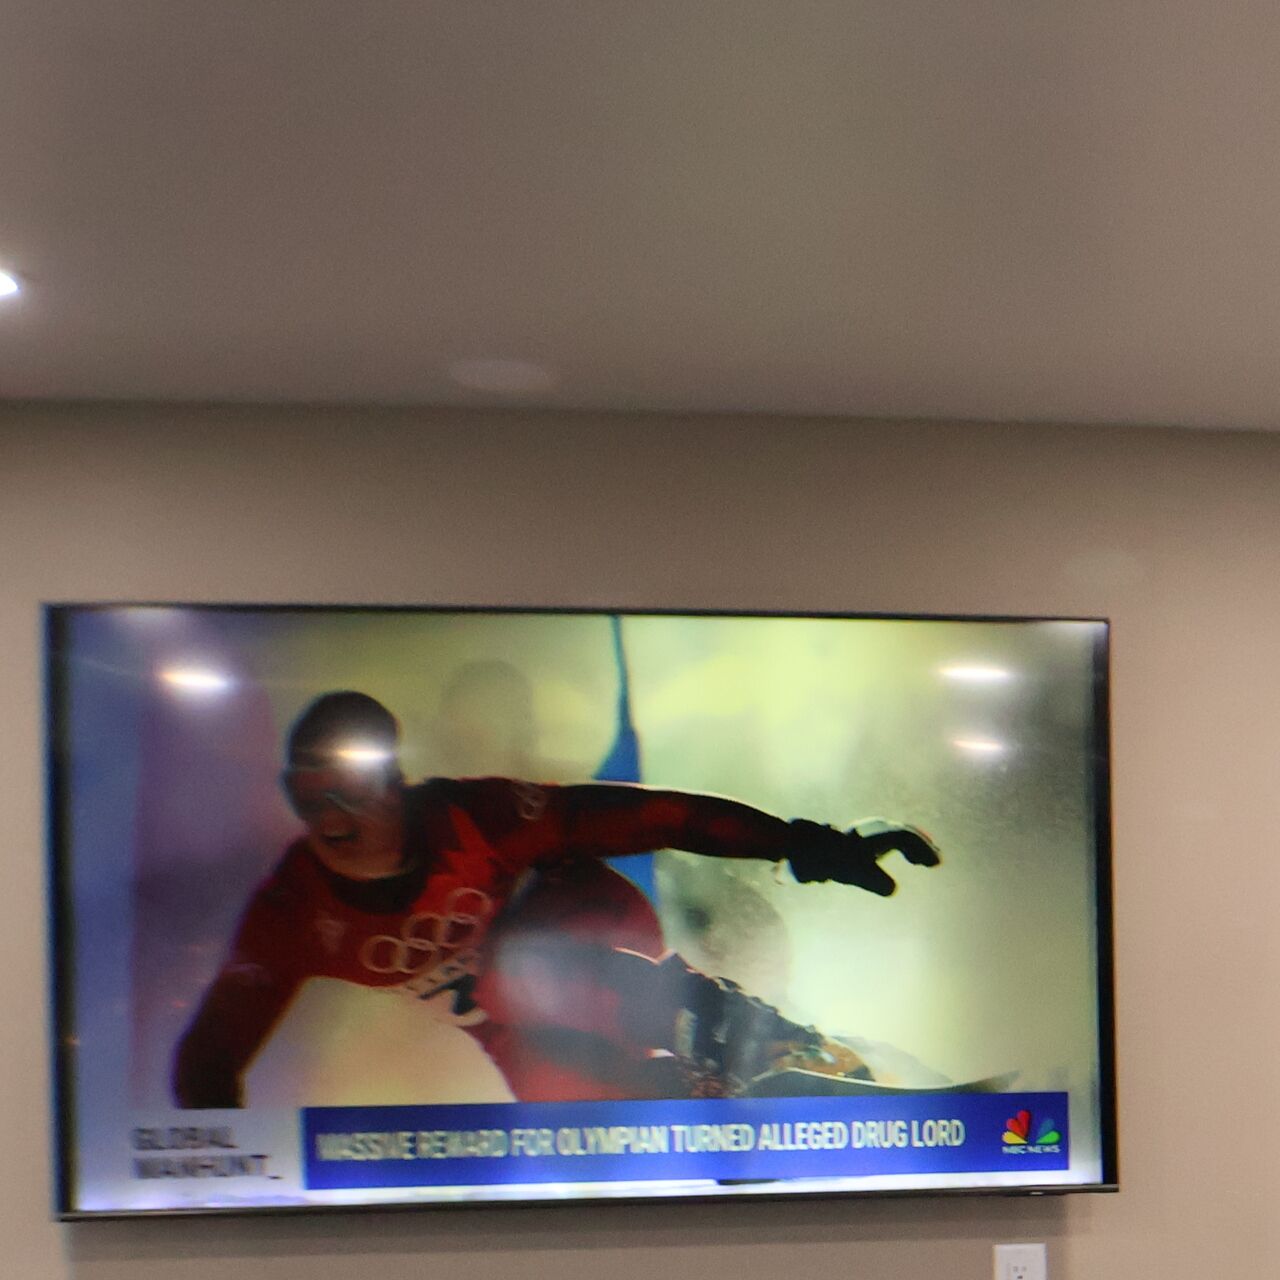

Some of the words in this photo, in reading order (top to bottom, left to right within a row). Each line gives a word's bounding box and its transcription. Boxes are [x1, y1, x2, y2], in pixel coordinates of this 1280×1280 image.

[316, 1130, 416, 1160] MASSIVE
[417, 1128, 509, 1158] REWARD
[510, 1128, 556, 1156] FOR
[556, 1125, 669, 1155] OLYMPIAN
[671, 1123, 756, 1152] TURNED
[758, 1121, 849, 1150] ALLEGED
[851, 1120, 910, 1148] DRUG
[911, 1119, 966, 1147] LORD
[1002, 1145, 1026, 1154] NBC
[1027, 1144, 1060, 1154] NEWS
